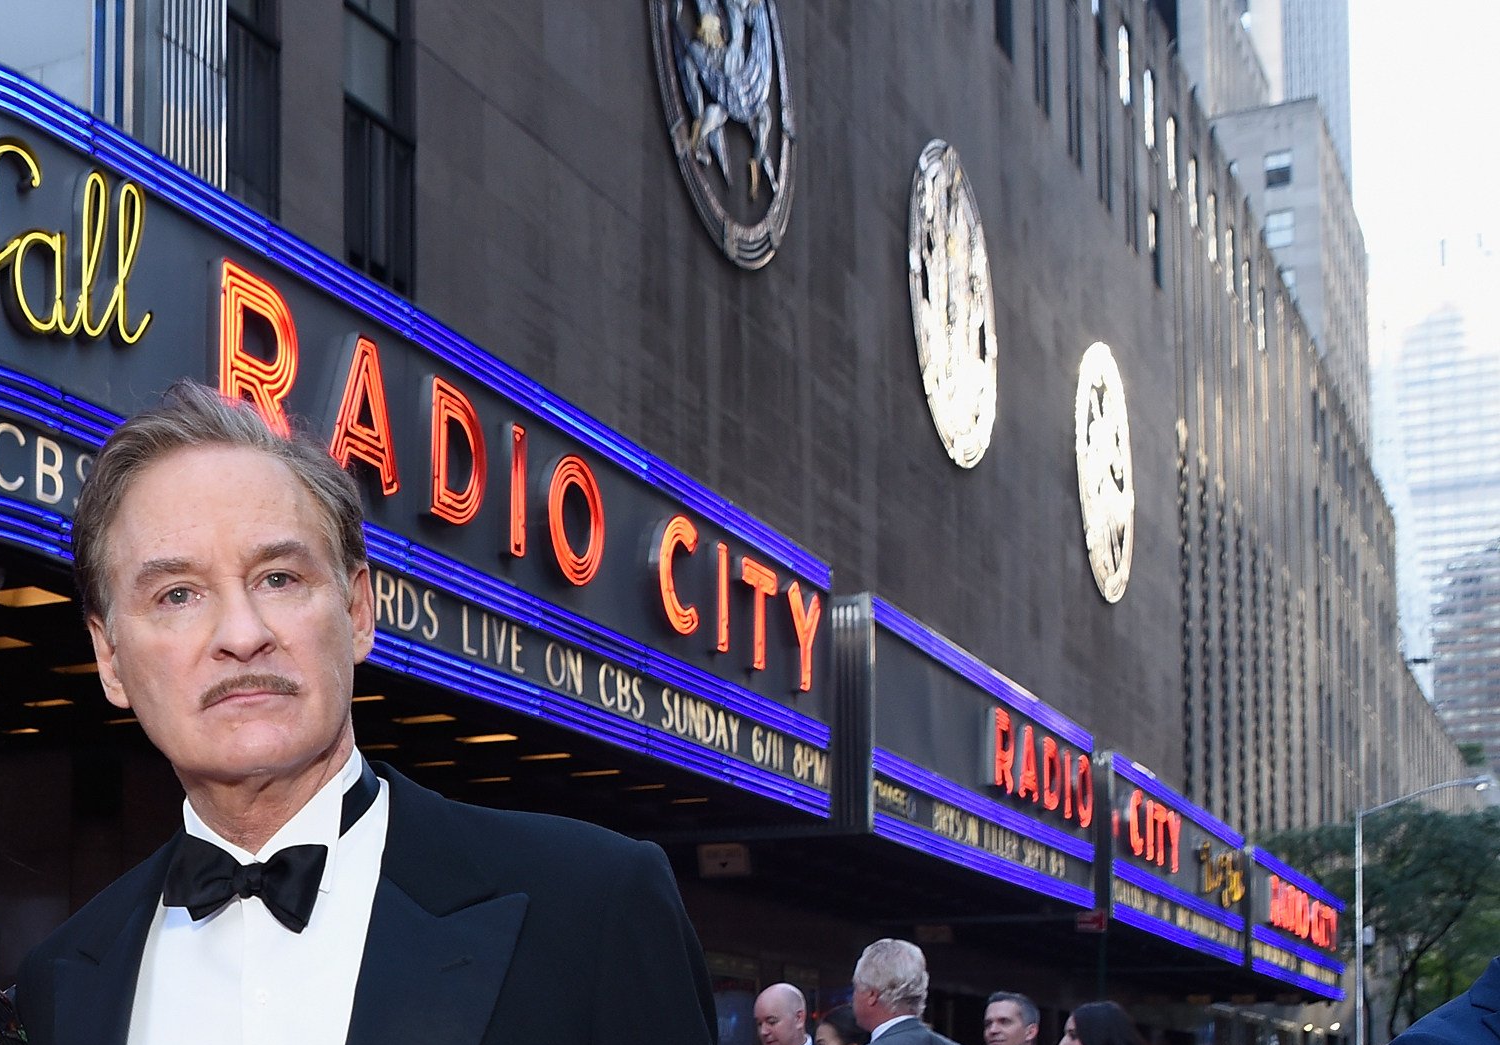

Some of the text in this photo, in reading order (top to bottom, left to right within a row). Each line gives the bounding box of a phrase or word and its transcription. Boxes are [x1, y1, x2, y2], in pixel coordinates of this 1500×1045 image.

[220, 258, 821, 692] RADIO CITY
[375, 569, 439, 640] RDS
[462, 604, 525, 674] LIVE
[545, 640, 583, 697] ON
[599, 662, 646, 720] CBS
[662, 687, 740, 754] SUNDAY
[751, 725, 784, 772] 6/11
[995, 707, 1093, 829] RADIO
[1129, 788, 1181, 874] CITY
